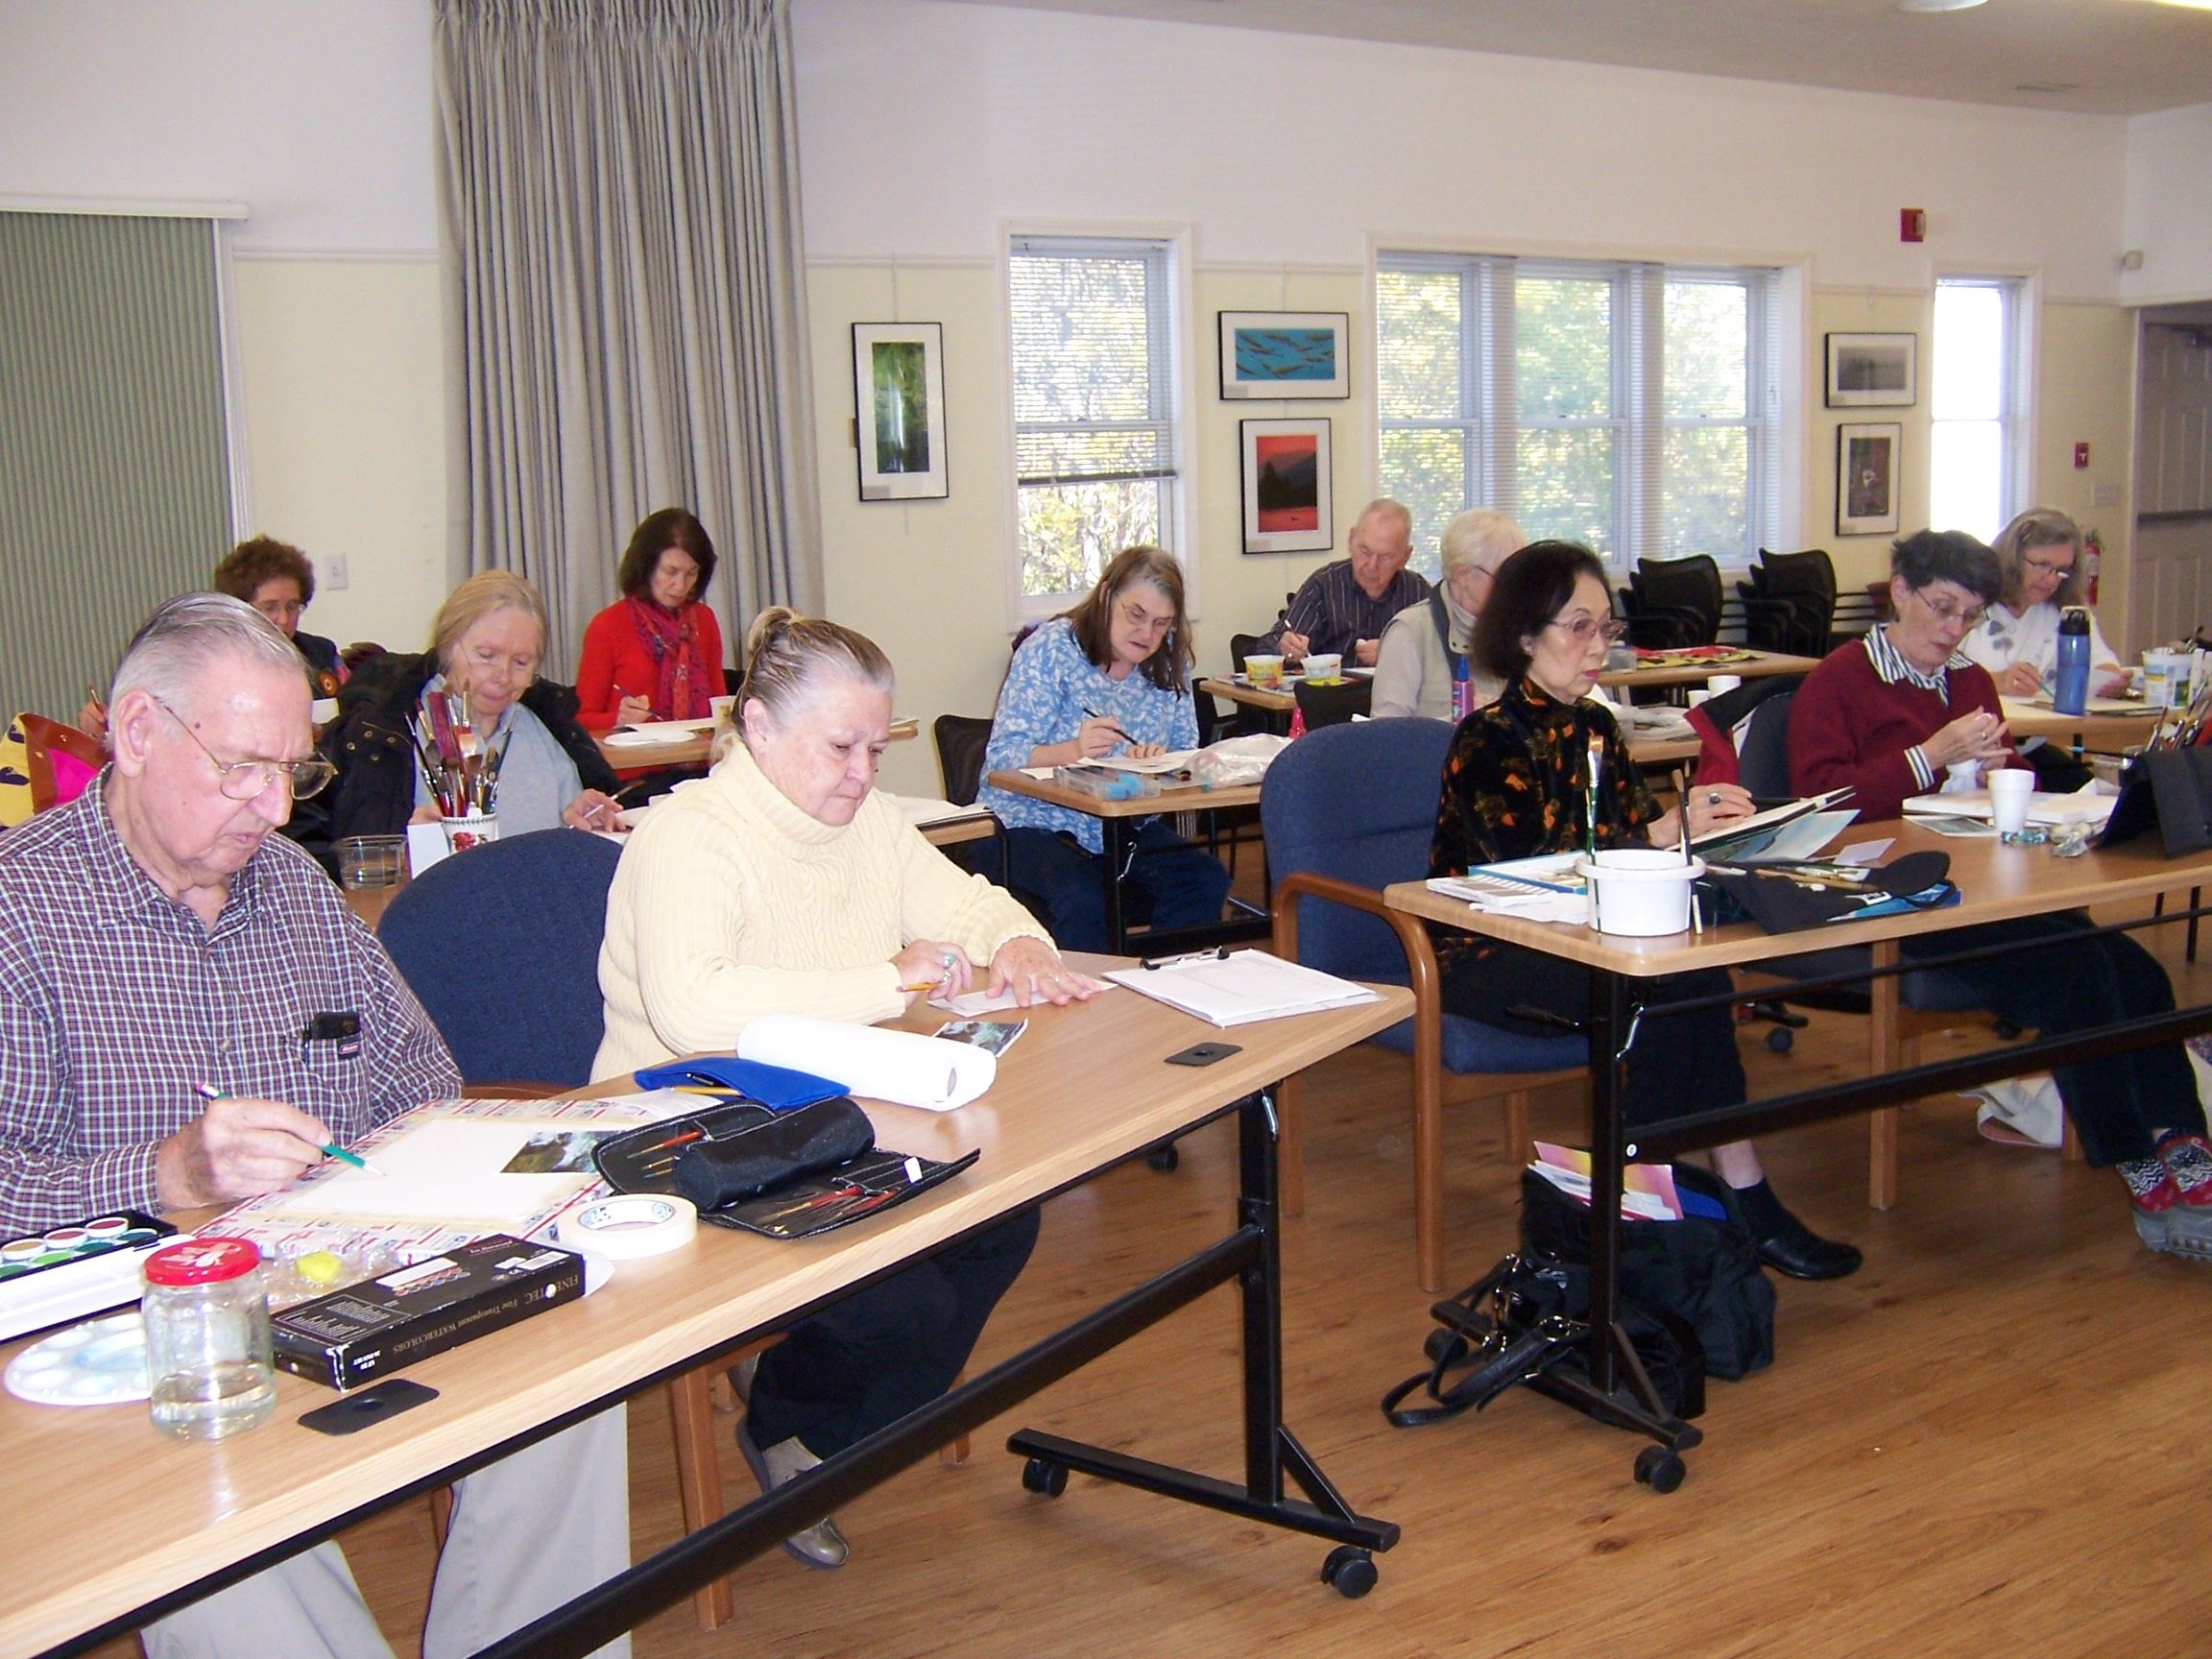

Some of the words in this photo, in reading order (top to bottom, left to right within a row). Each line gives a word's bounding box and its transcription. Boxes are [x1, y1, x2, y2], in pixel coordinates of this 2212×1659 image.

[501, 1300, 518, 1311] Fine
[457, 1306, 502, 1328] Transparent
[392, 1322, 457, 1355] WATERCOLORS
